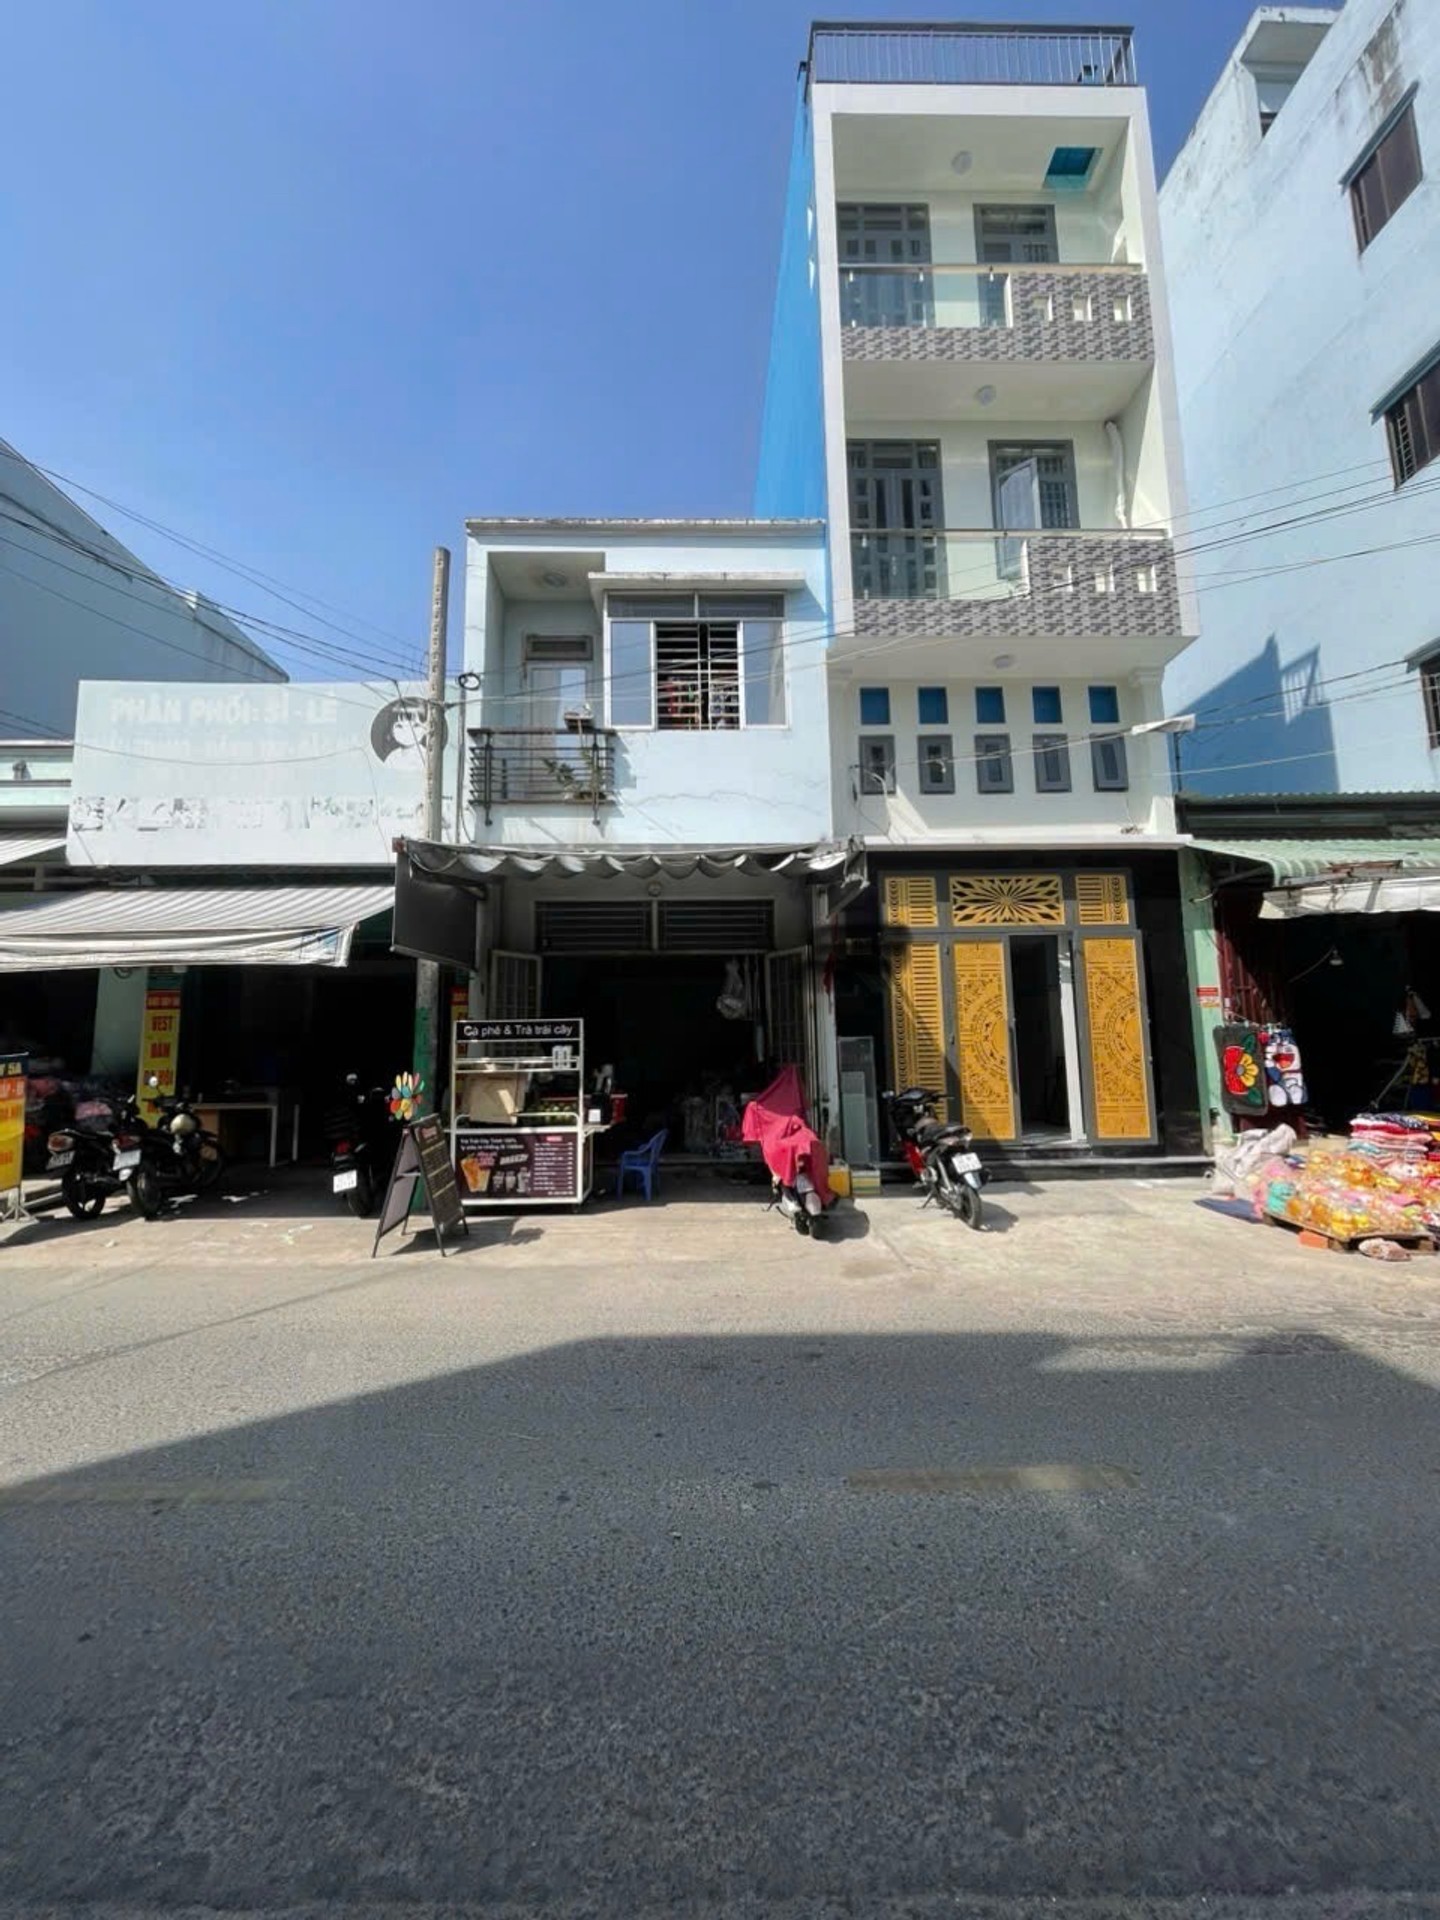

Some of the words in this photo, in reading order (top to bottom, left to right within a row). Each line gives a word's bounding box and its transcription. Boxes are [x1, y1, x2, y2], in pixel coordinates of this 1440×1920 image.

[503, 1024, 512, 1035] &
[514, 1024, 532, 1035] Trà
[534, 1024, 552, 1035] trái
[553, 1024, 573, 1037] cây
